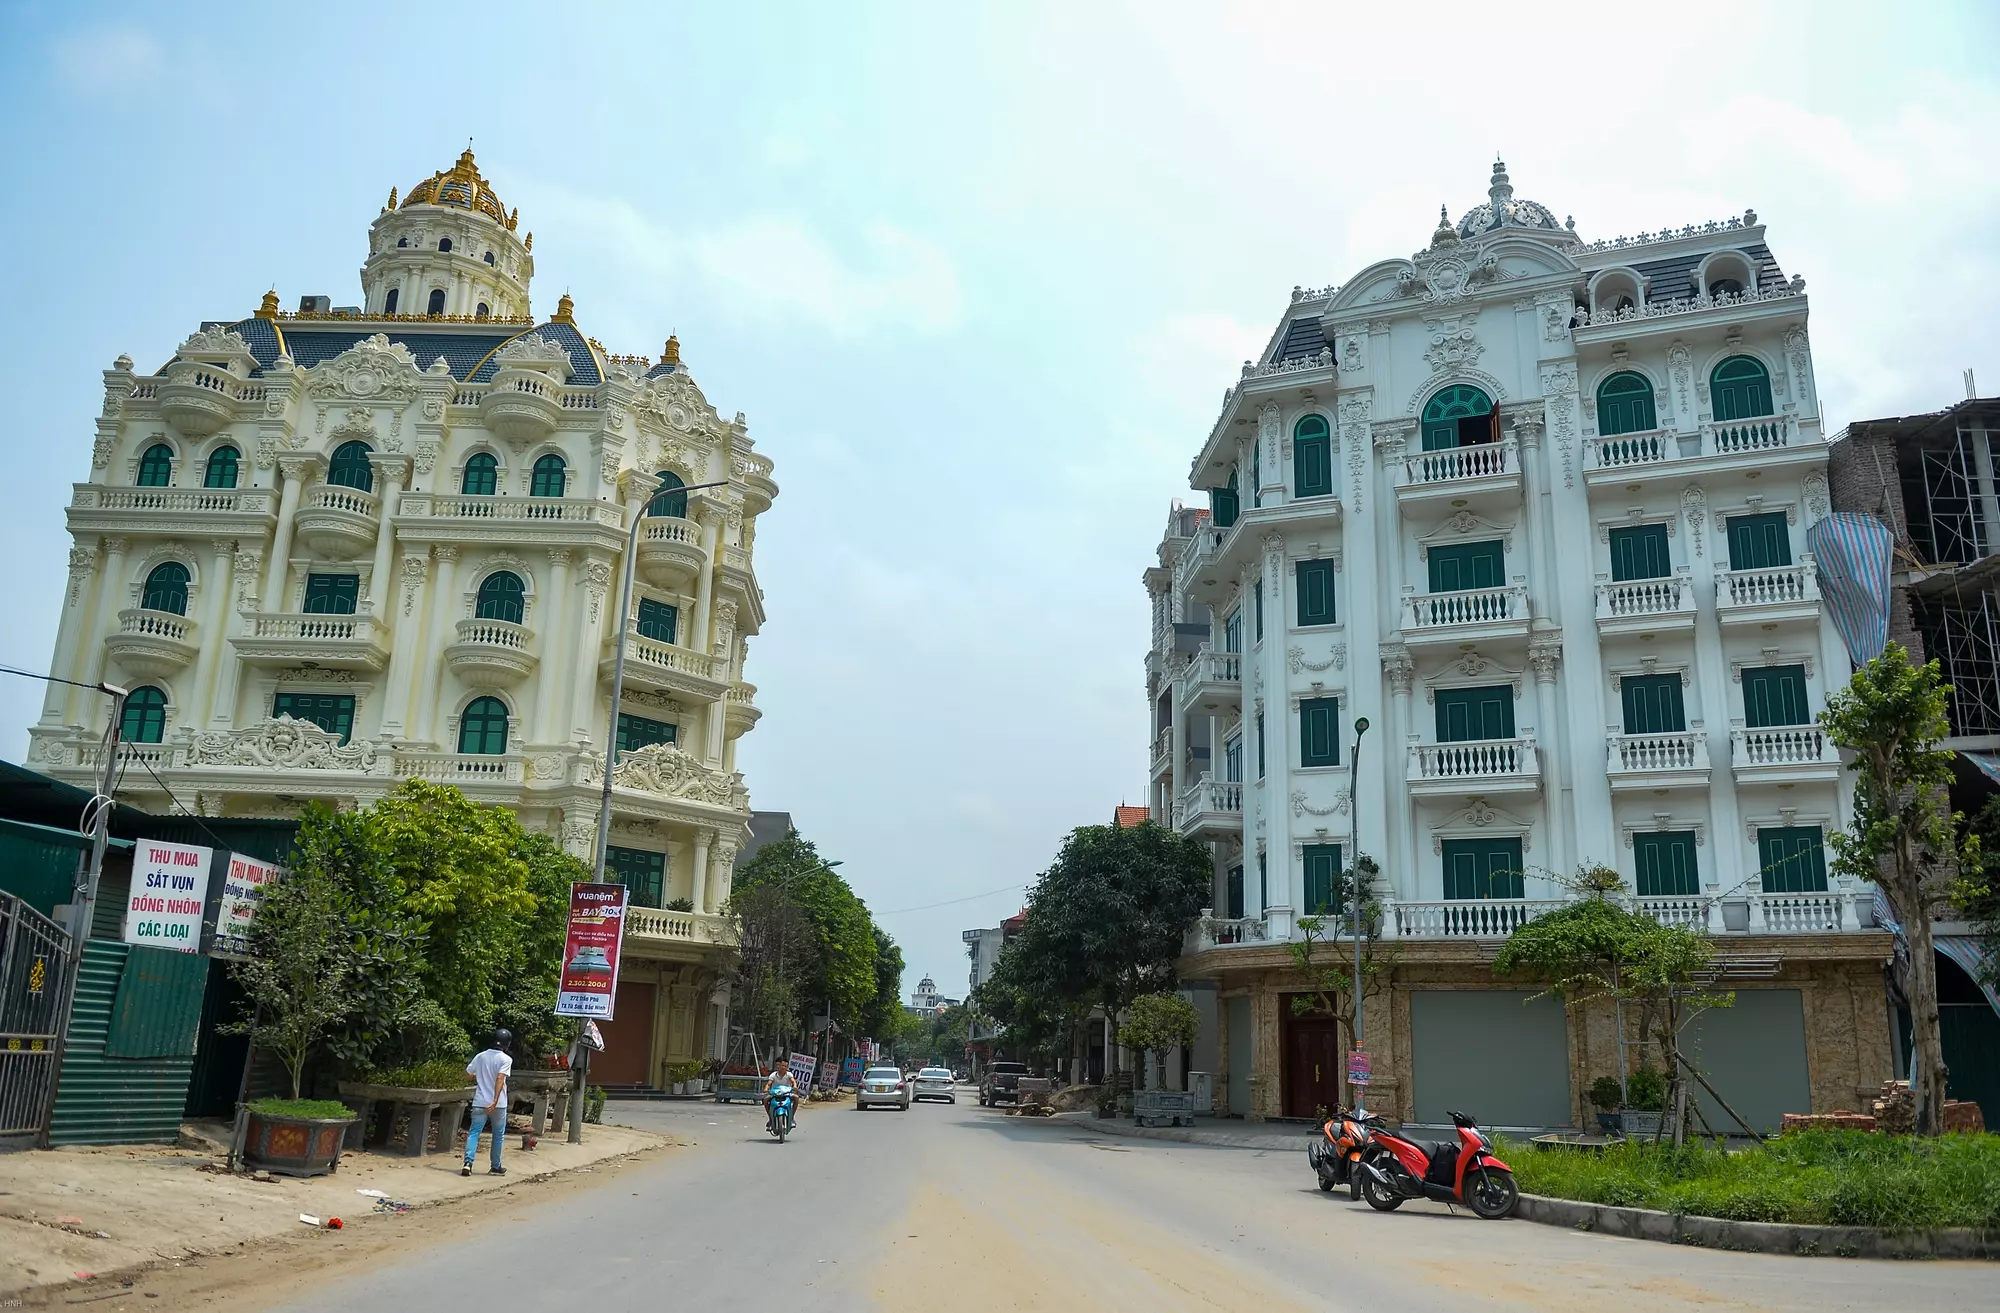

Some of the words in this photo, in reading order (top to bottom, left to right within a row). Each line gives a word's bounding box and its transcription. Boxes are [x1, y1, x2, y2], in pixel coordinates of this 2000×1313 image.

[149, 849, 171, 864] THU
[173, 851, 198, 867] MUA
[146, 868, 169, 888] SẮT
[171, 875, 195, 893] VỤN
[230, 860, 246, 880] THU
[246, 864, 263, 884] MUA
[166, 898, 201, 915] NHÔM
[582, 908, 600, 917] BAY
[137, 920, 161, 937] CÁC
[164, 923, 190, 941] LOẠI
